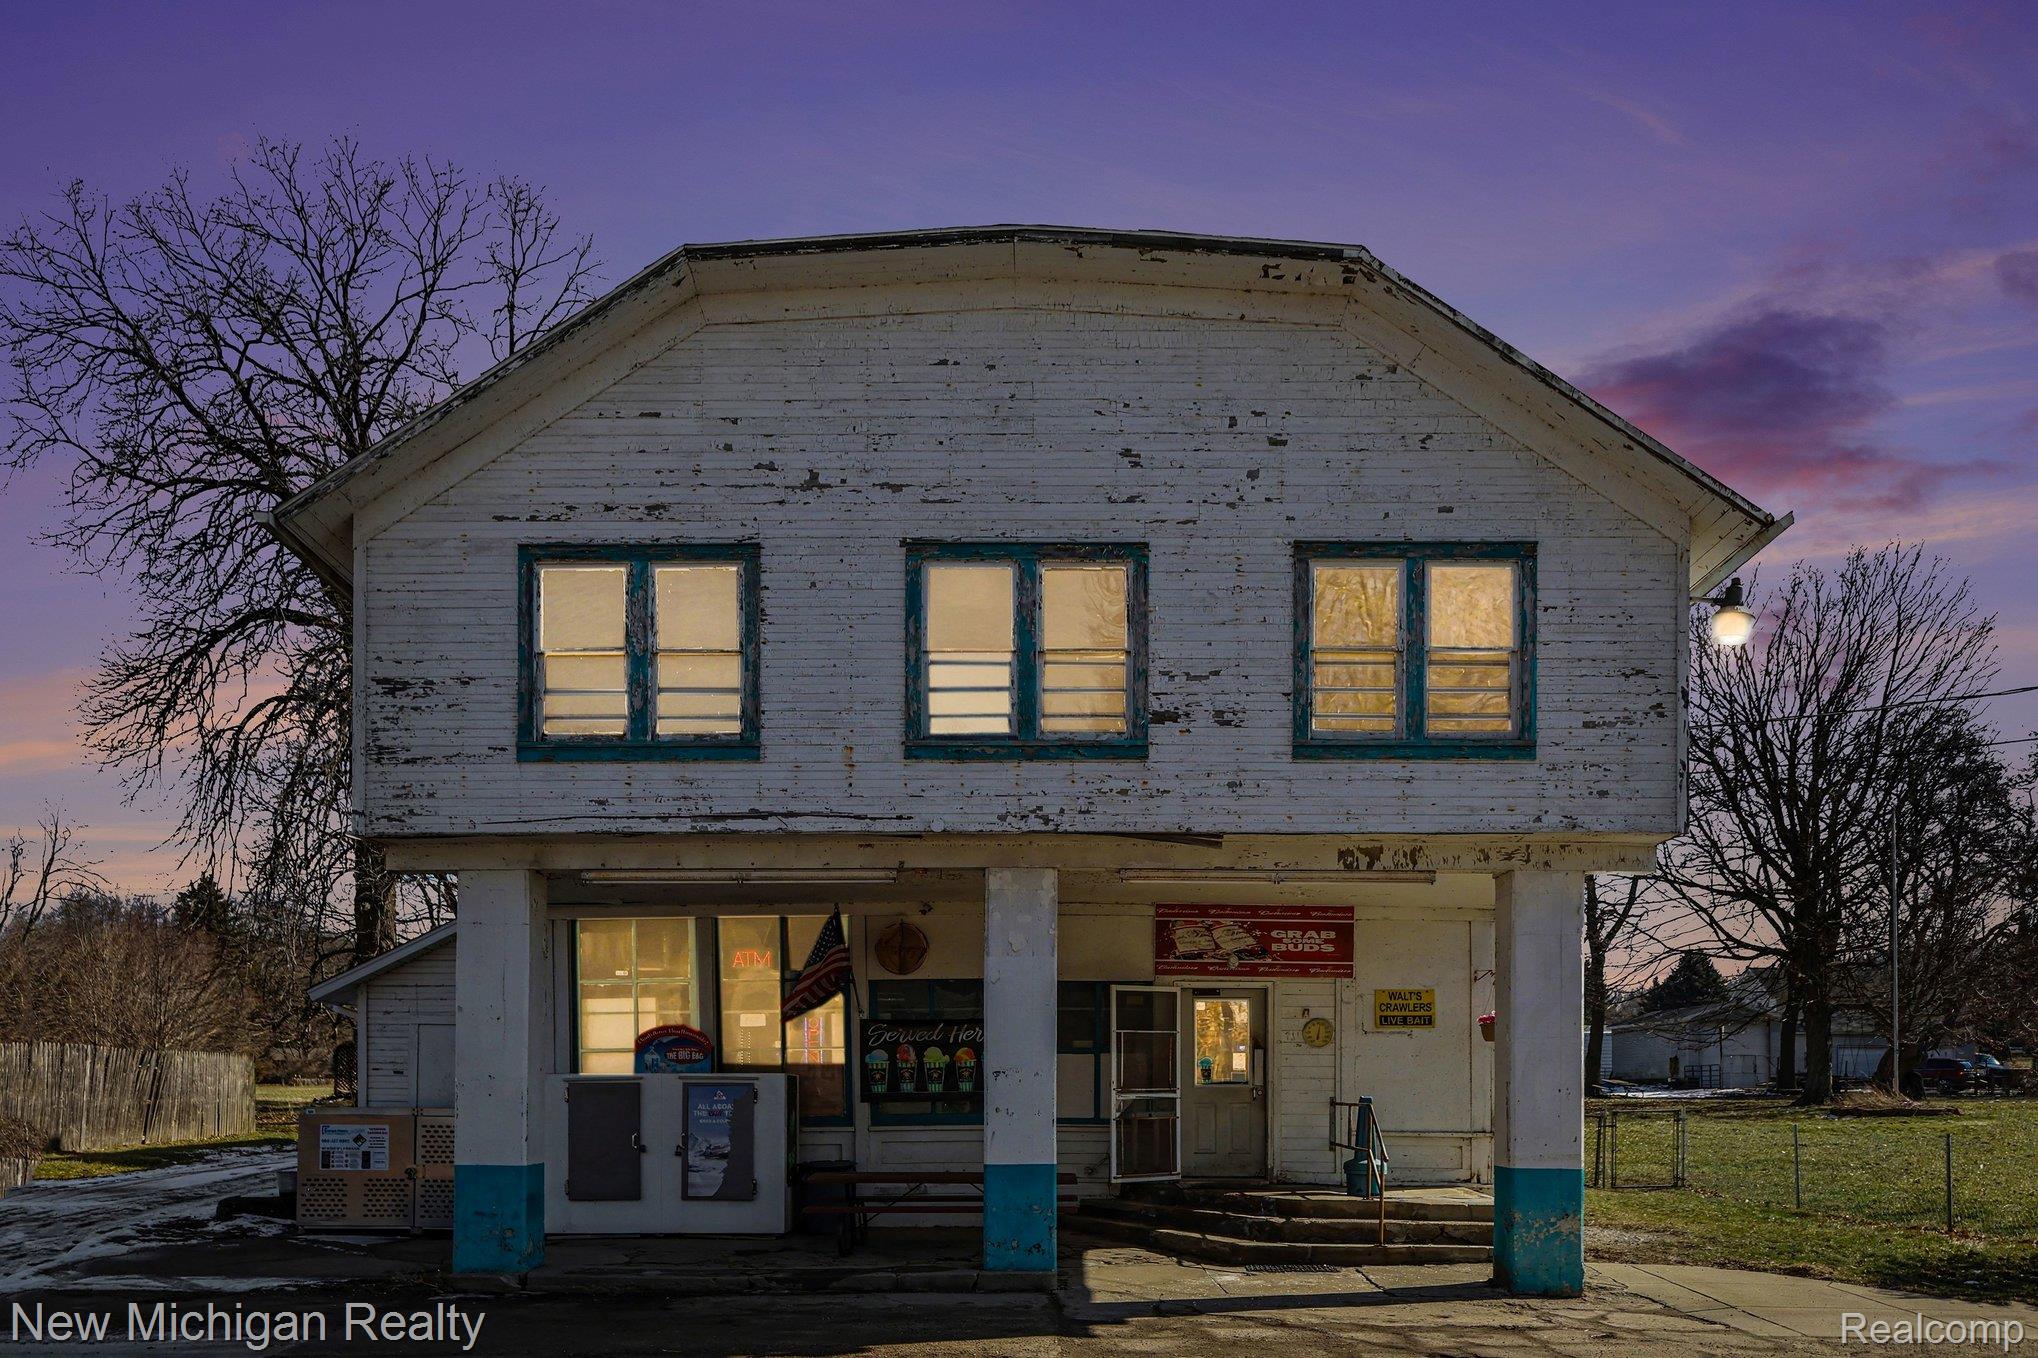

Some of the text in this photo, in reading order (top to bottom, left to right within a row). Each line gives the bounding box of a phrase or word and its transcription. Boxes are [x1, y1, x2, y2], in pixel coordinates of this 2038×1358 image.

[1270, 930, 1337, 939] GRAB
[1271, 943, 1336, 952] BUDS
[731, 950, 772, 968] ATM
[1388, 991, 1422, 1001] WALT'S
[1379, 1002, 1432, 1012] CRAWLERS
[1381, 1016, 1431, 1025] LIVE BAIT
[868, 1022, 985, 1047] Served Her
[666, 1052, 677, 1060] THE
[678, 1050, 691, 1060] BIG
